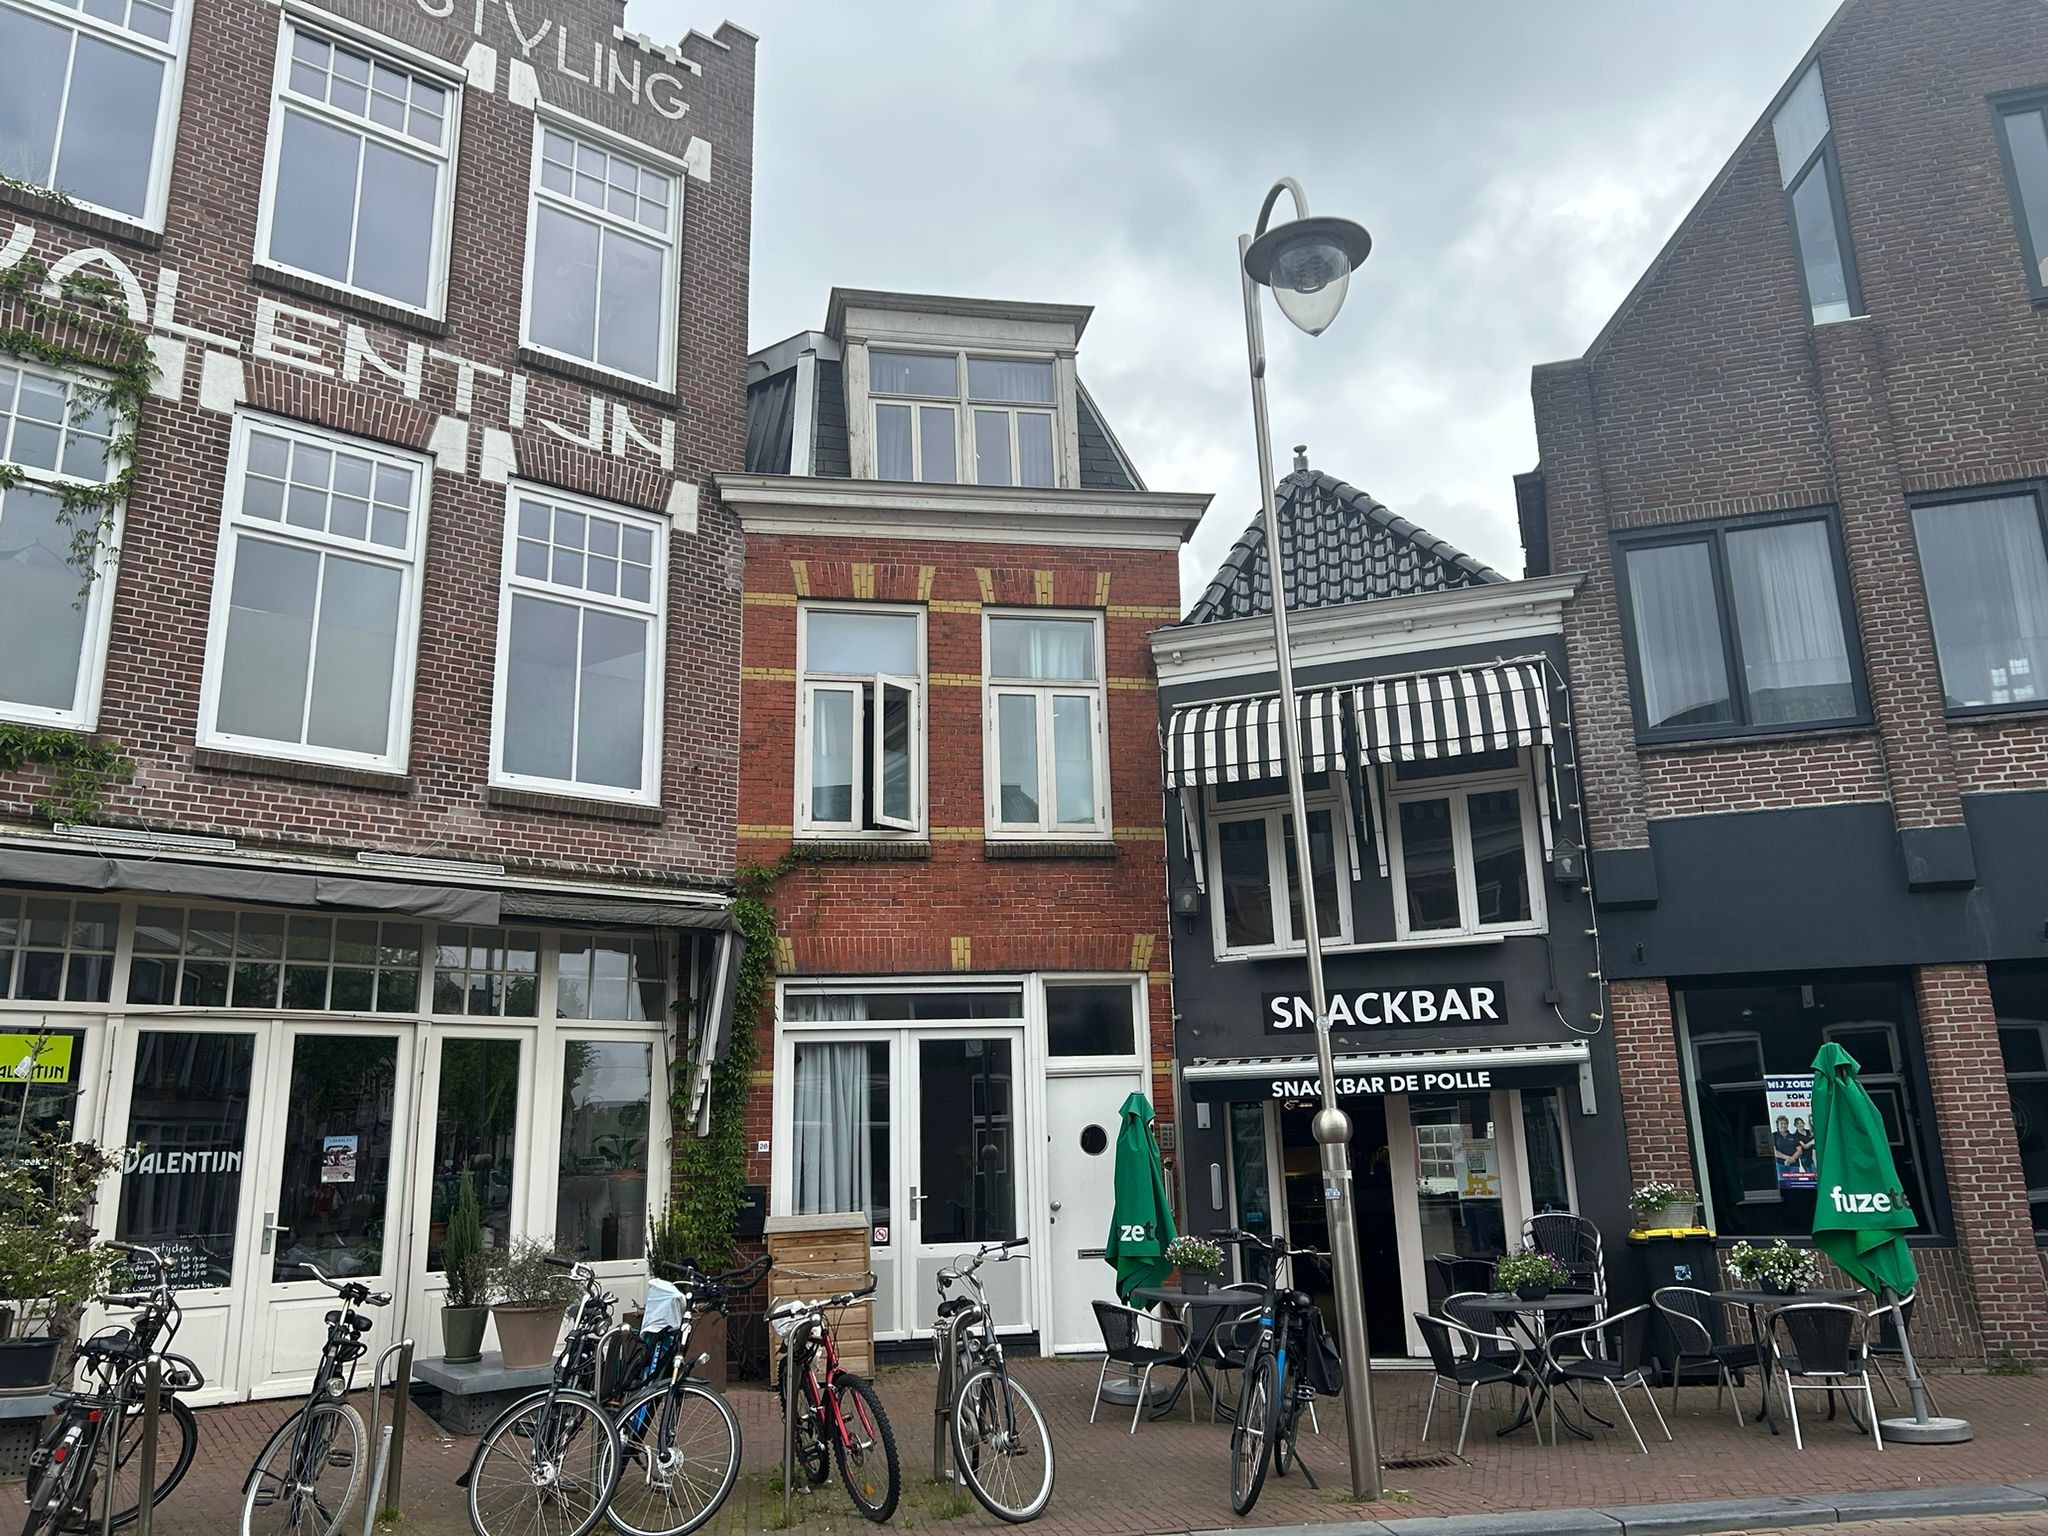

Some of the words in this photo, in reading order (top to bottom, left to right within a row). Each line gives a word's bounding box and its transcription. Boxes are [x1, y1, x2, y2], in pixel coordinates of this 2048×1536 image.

[1390, 1074, 1419, 1093] DE
[1424, 1071, 1492, 1091] POLLE
[1767, 1081, 1784, 1089] WIJ
[1785, 1080, 1814, 1089] ZOEK
[123, 1150, 242, 1175] VALENTIJN
